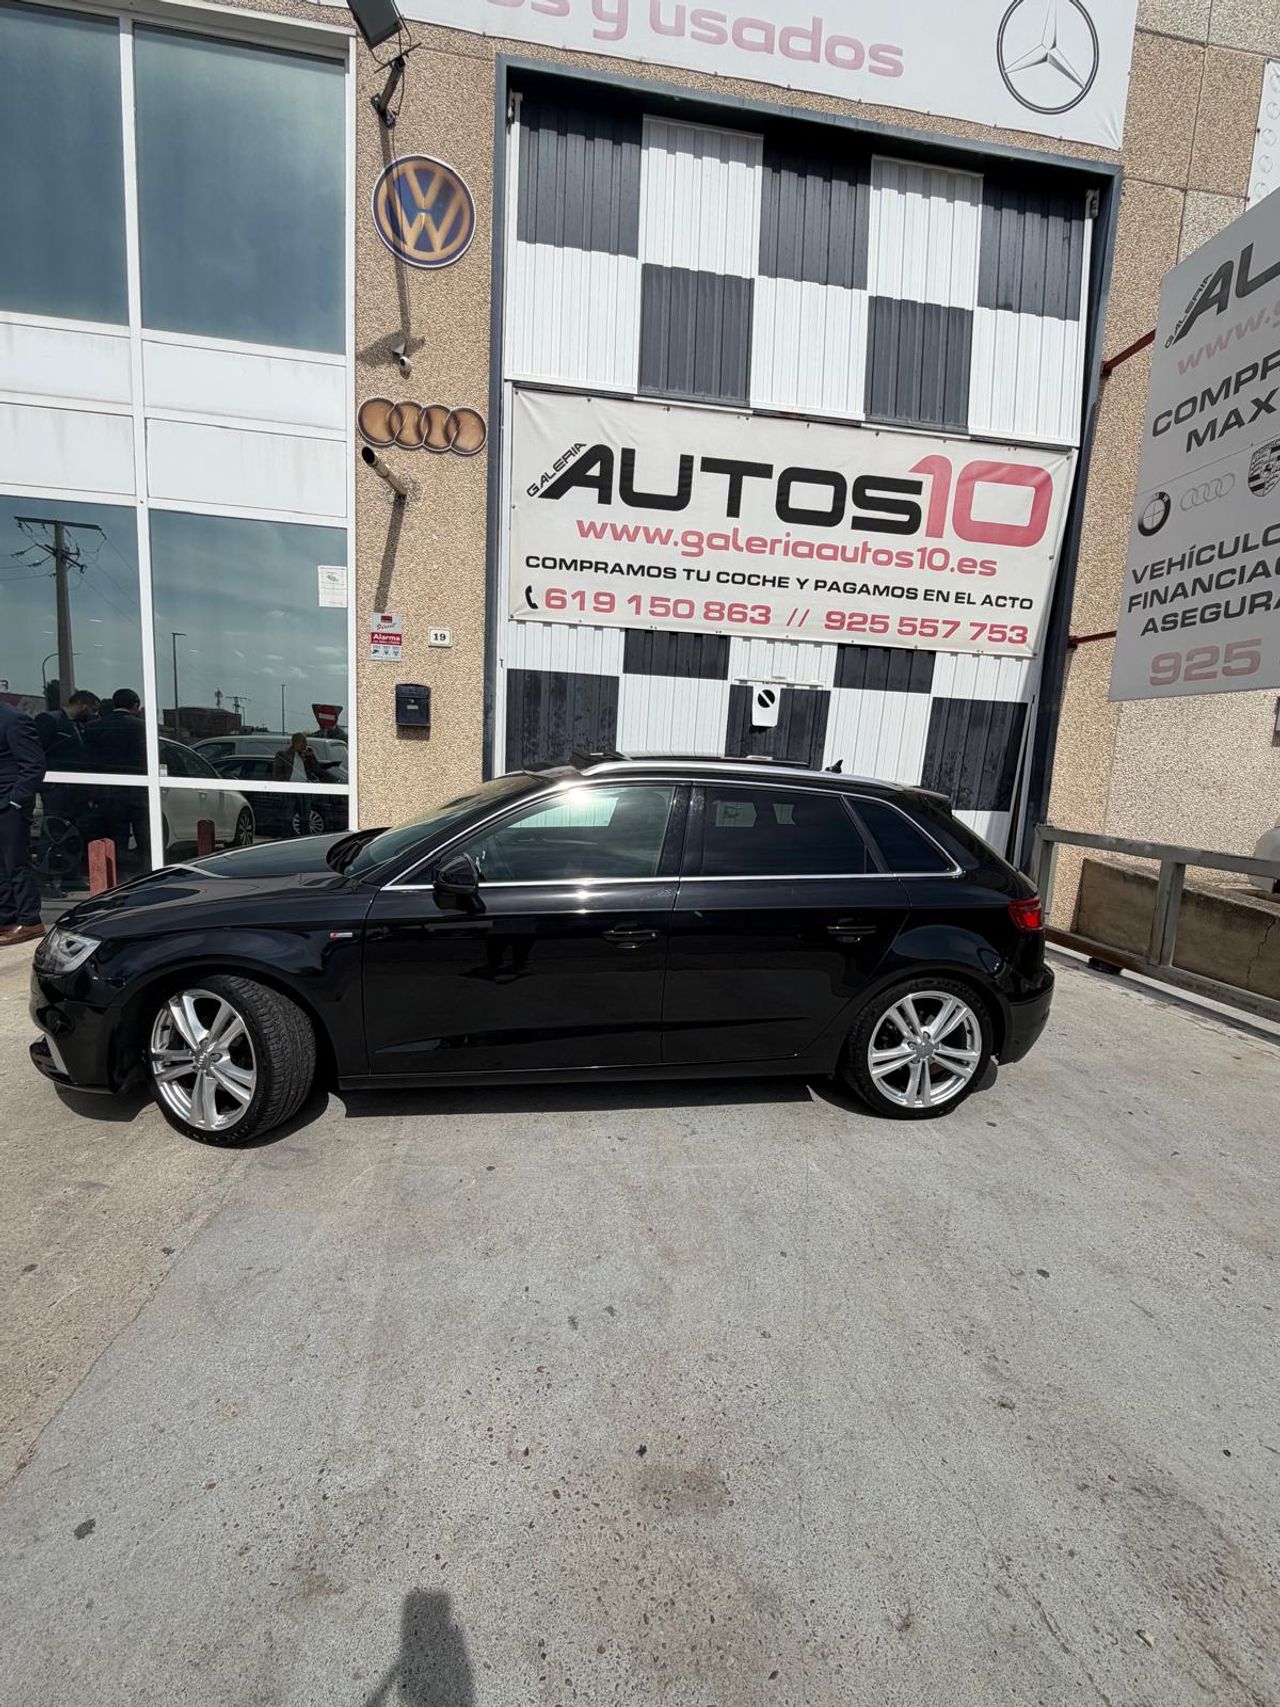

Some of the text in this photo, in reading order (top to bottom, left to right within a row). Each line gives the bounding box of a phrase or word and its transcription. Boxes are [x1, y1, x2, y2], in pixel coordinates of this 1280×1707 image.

[649, 0, 906, 78] usados
[1164, 273, 1213, 349] GALERIA
[526, 442, 587, 497] GALERIA
[576, 519, 998, 577] www.galeriaautos10.es
[525, 555, 1034, 610] COMPRAMOS TU COCHE Y PAGAMOS EN EL ACTO
[1127, 555, 1280, 613] FINANCIA
[433, 632, 446, 642] 19
[544, 587, 616, 614] 619
[626, 594, 695, 620] 150
[703, 600, 772, 625] 863
[824, 610, 890, 634] 925
[897, 616, 961, 639] 557
[969, 622, 1029, 645] 753
[1149, 638, 1263, 687] 925
